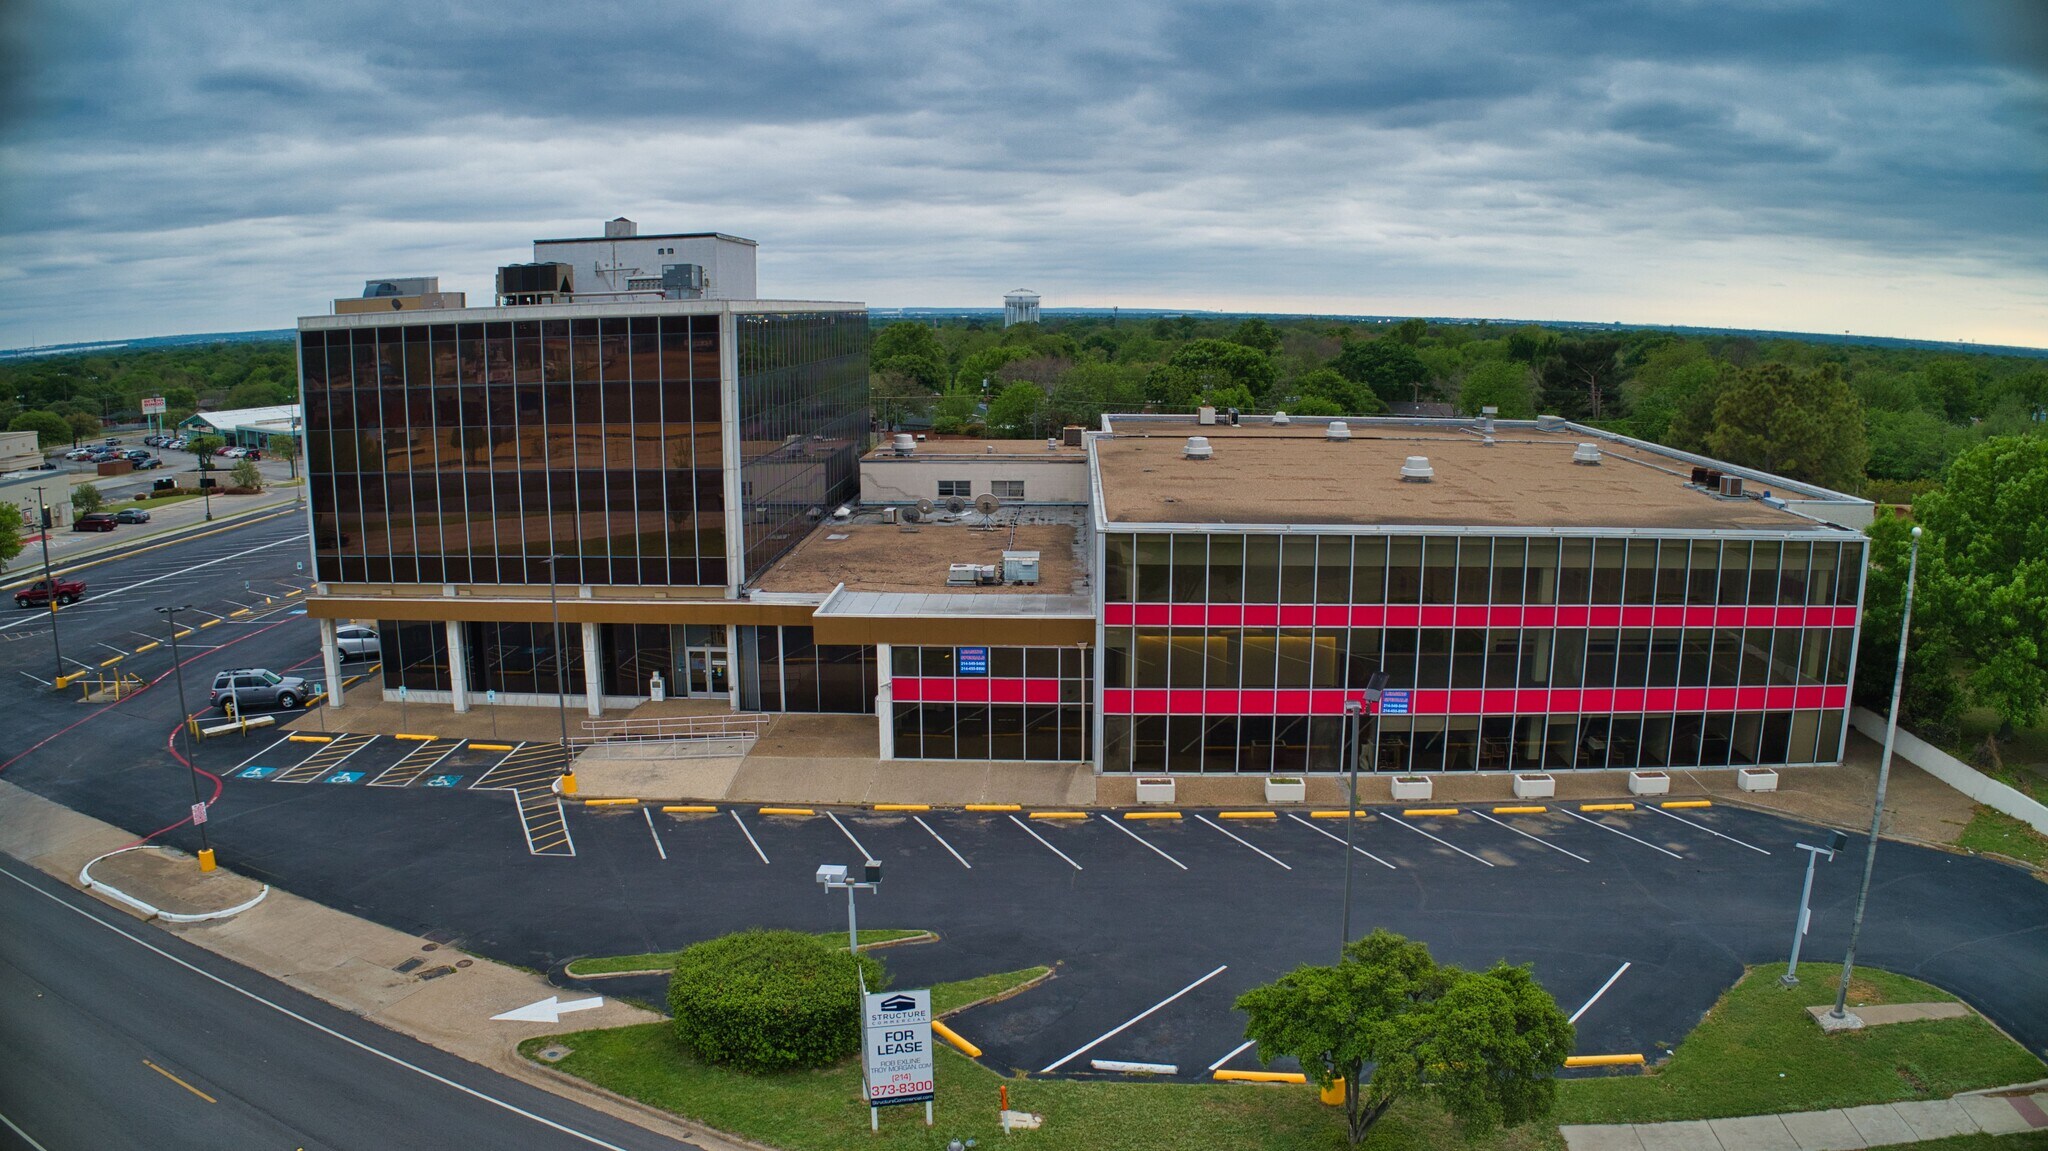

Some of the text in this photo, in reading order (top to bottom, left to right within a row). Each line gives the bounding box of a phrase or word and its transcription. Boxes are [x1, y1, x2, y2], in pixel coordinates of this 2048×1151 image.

[872, 1010, 925, 1020] STRUCTURE
[871, 1017, 926, 1025] COMMERCIAL
[885, 1030, 914, 1042] FOR
[877, 1041, 923, 1055] LEASE
[892, 1073, 912, 1082] (214)
[872, 1080, 932, 1096] 373-8300
[872, 1096, 933, 1106] StructureCommercial.com
